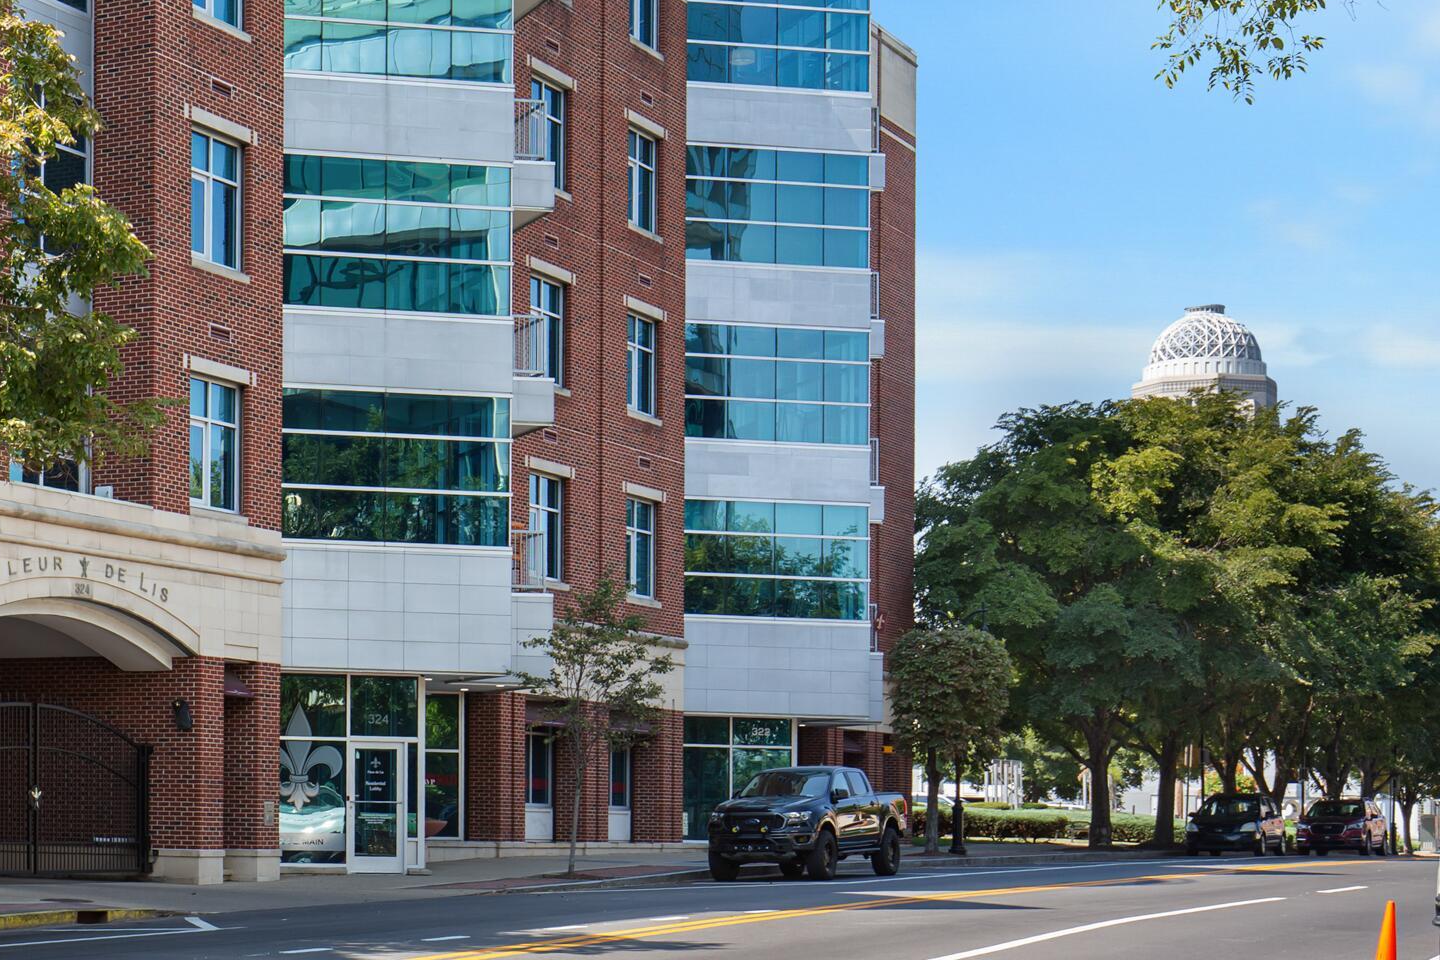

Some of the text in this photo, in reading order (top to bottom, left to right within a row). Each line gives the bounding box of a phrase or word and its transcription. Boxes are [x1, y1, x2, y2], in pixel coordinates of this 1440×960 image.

[105, 564, 127, 583] DE
[139, 572, 169, 602] LIS
[74, 583, 91, 596] 324
[368, 713, 389, 725] 324
[751, 727, 771, 737] 322
